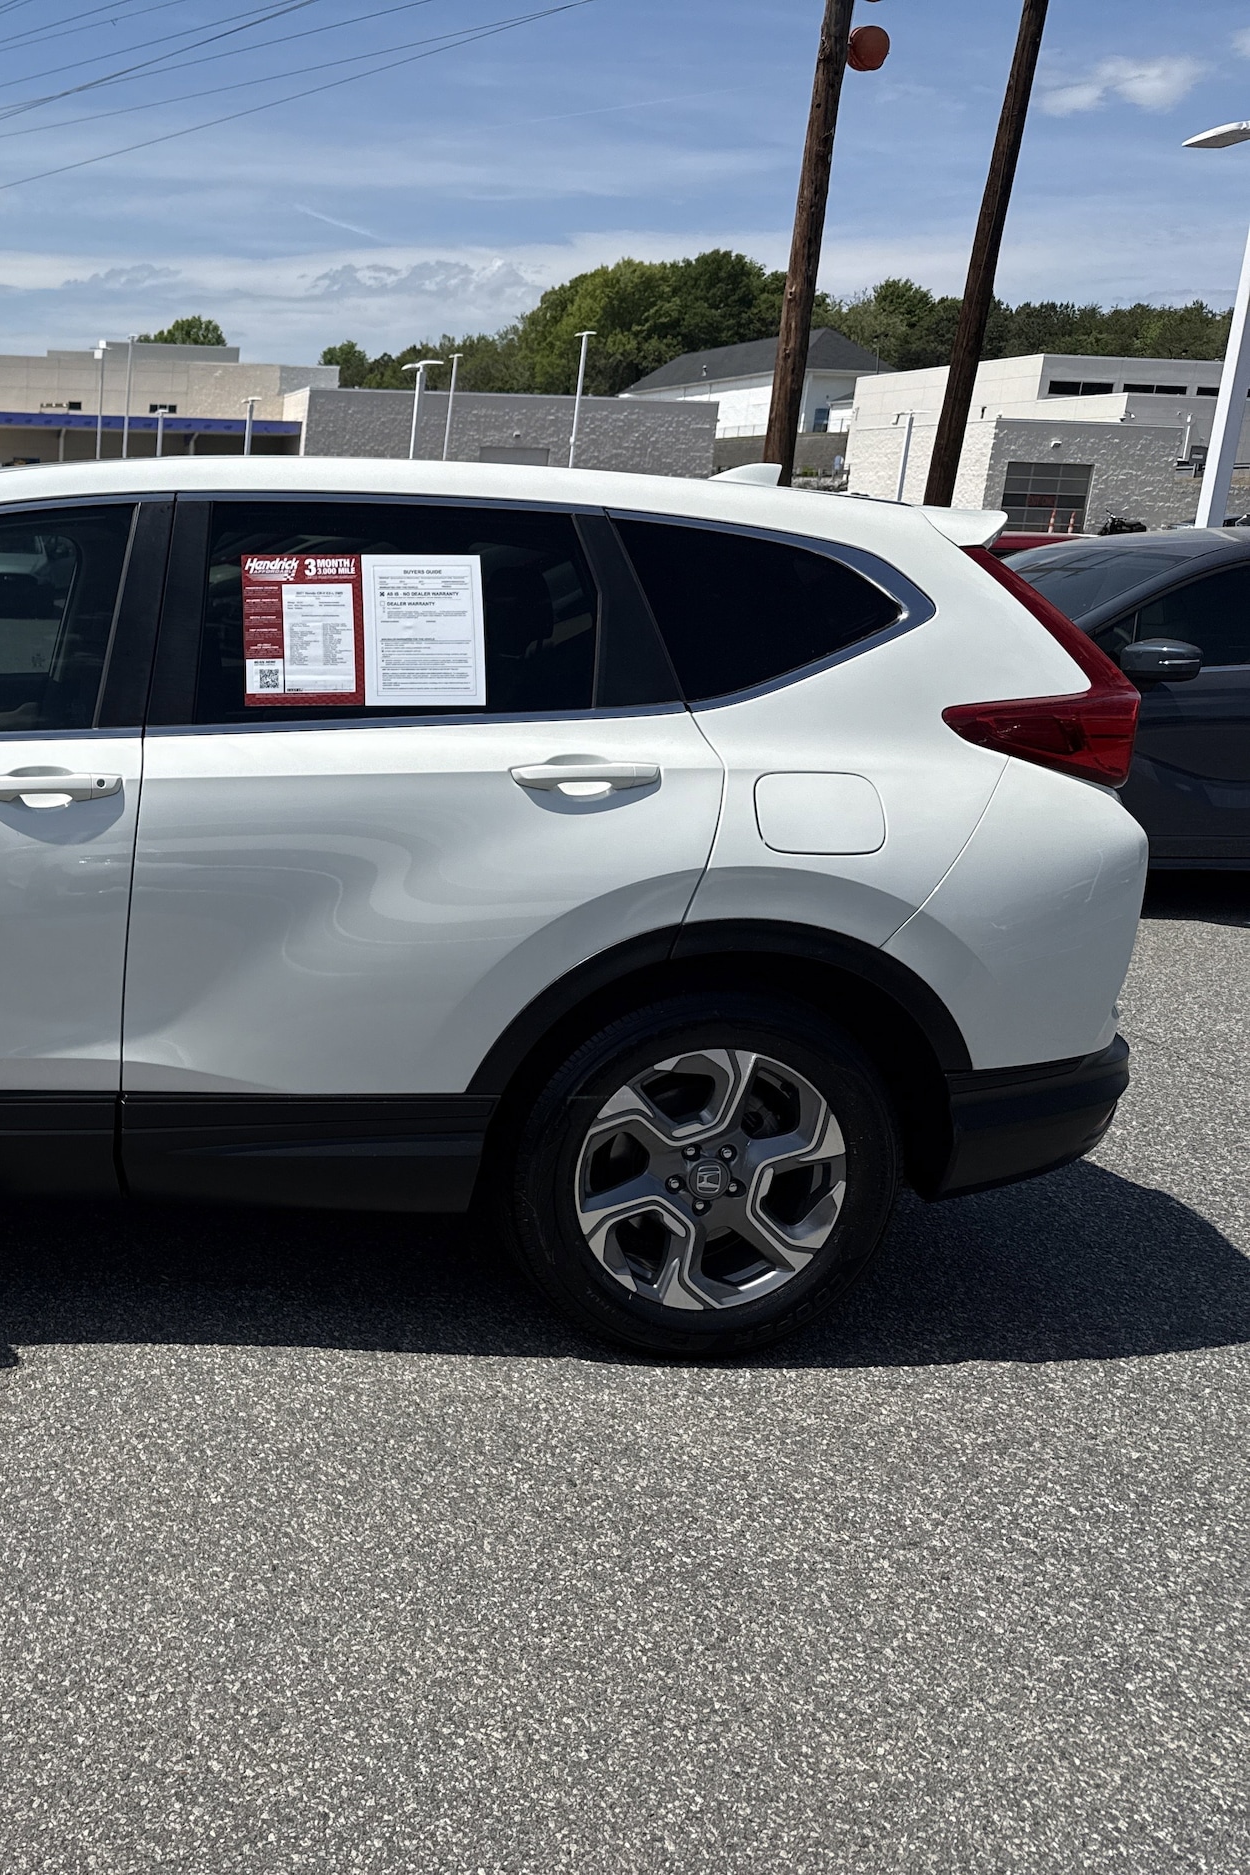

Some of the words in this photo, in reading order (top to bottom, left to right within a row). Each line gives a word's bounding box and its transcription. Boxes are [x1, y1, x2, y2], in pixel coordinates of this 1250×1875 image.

[245, 557, 300, 574] Hendrick
[304, 558, 316, 576] 3
[732, 1272, 844, 1346] COOPER
